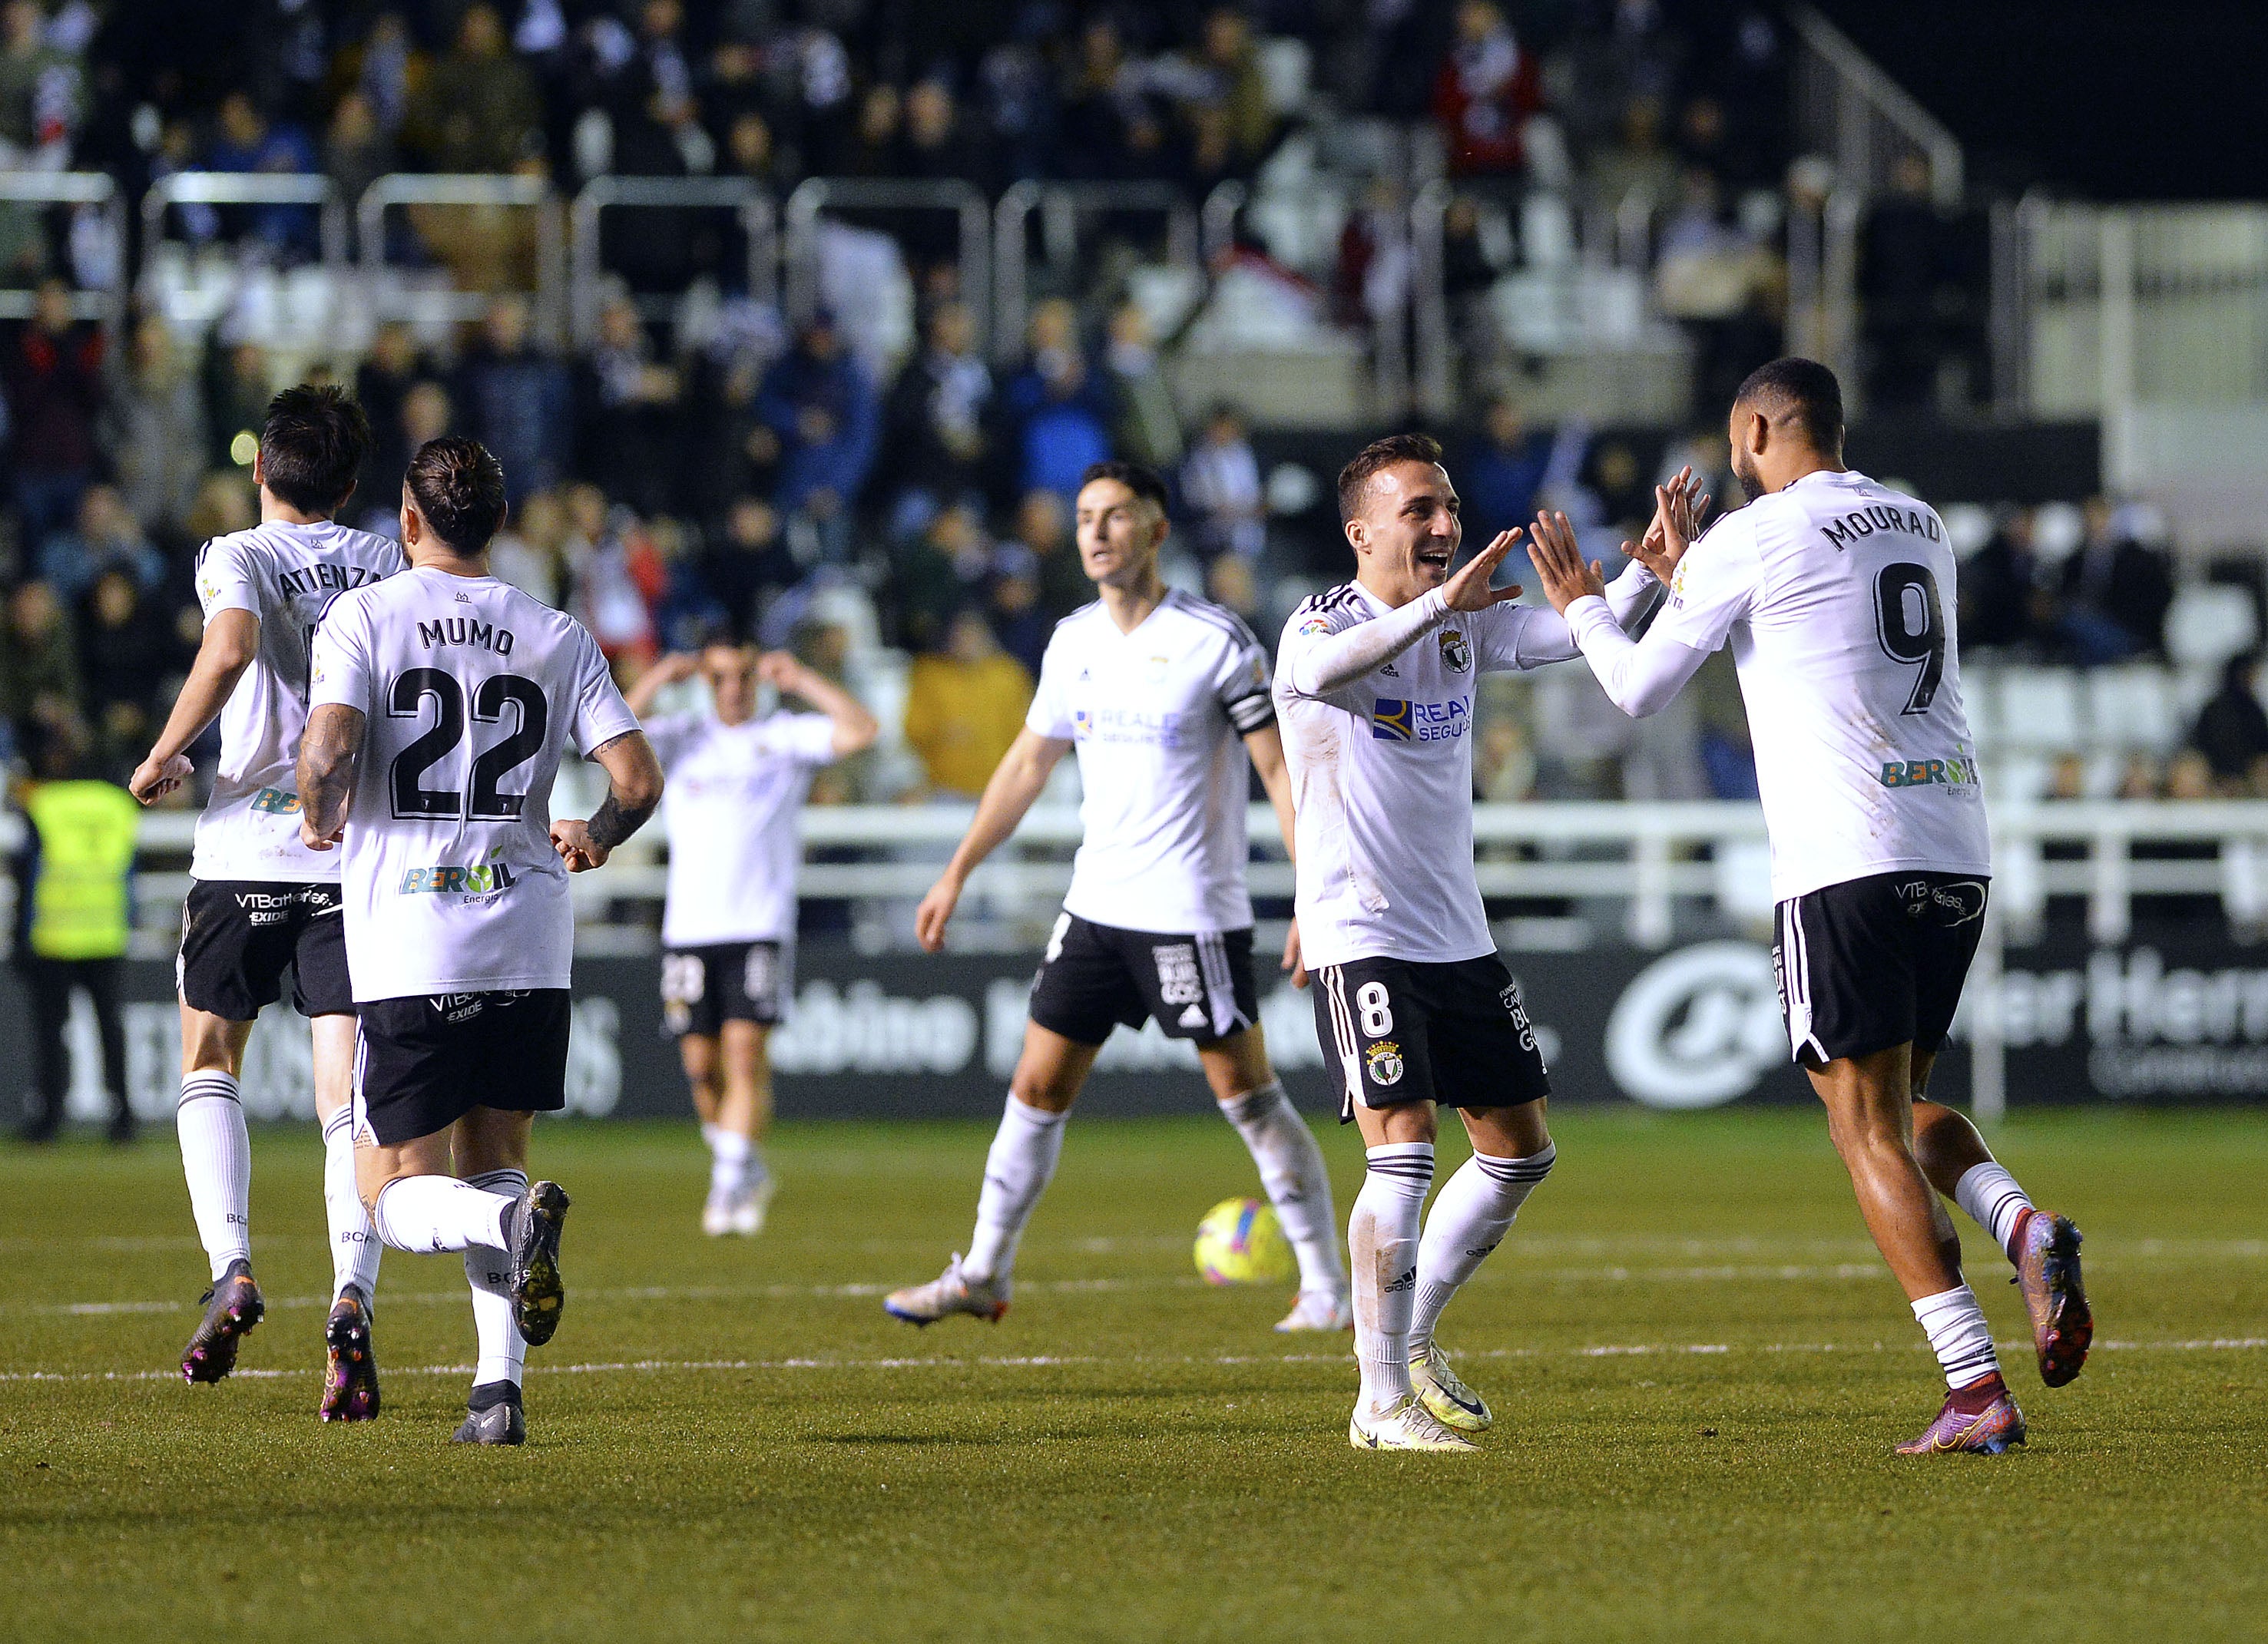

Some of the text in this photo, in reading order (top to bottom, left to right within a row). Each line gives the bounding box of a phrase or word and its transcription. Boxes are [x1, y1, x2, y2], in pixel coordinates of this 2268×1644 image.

[1819, 506, 1941, 552] MOURAD
[417, 617, 515, 657] MUMO
[1872, 561, 1945, 716] 9
[386, 667, 548, 823] 22
[400, 862, 516, 894] BEROIL
[250, 911, 289, 922] EXIDE
[447, 1000, 482, 1021] EXIDE
[1356, 981, 1393, 1038] 8
